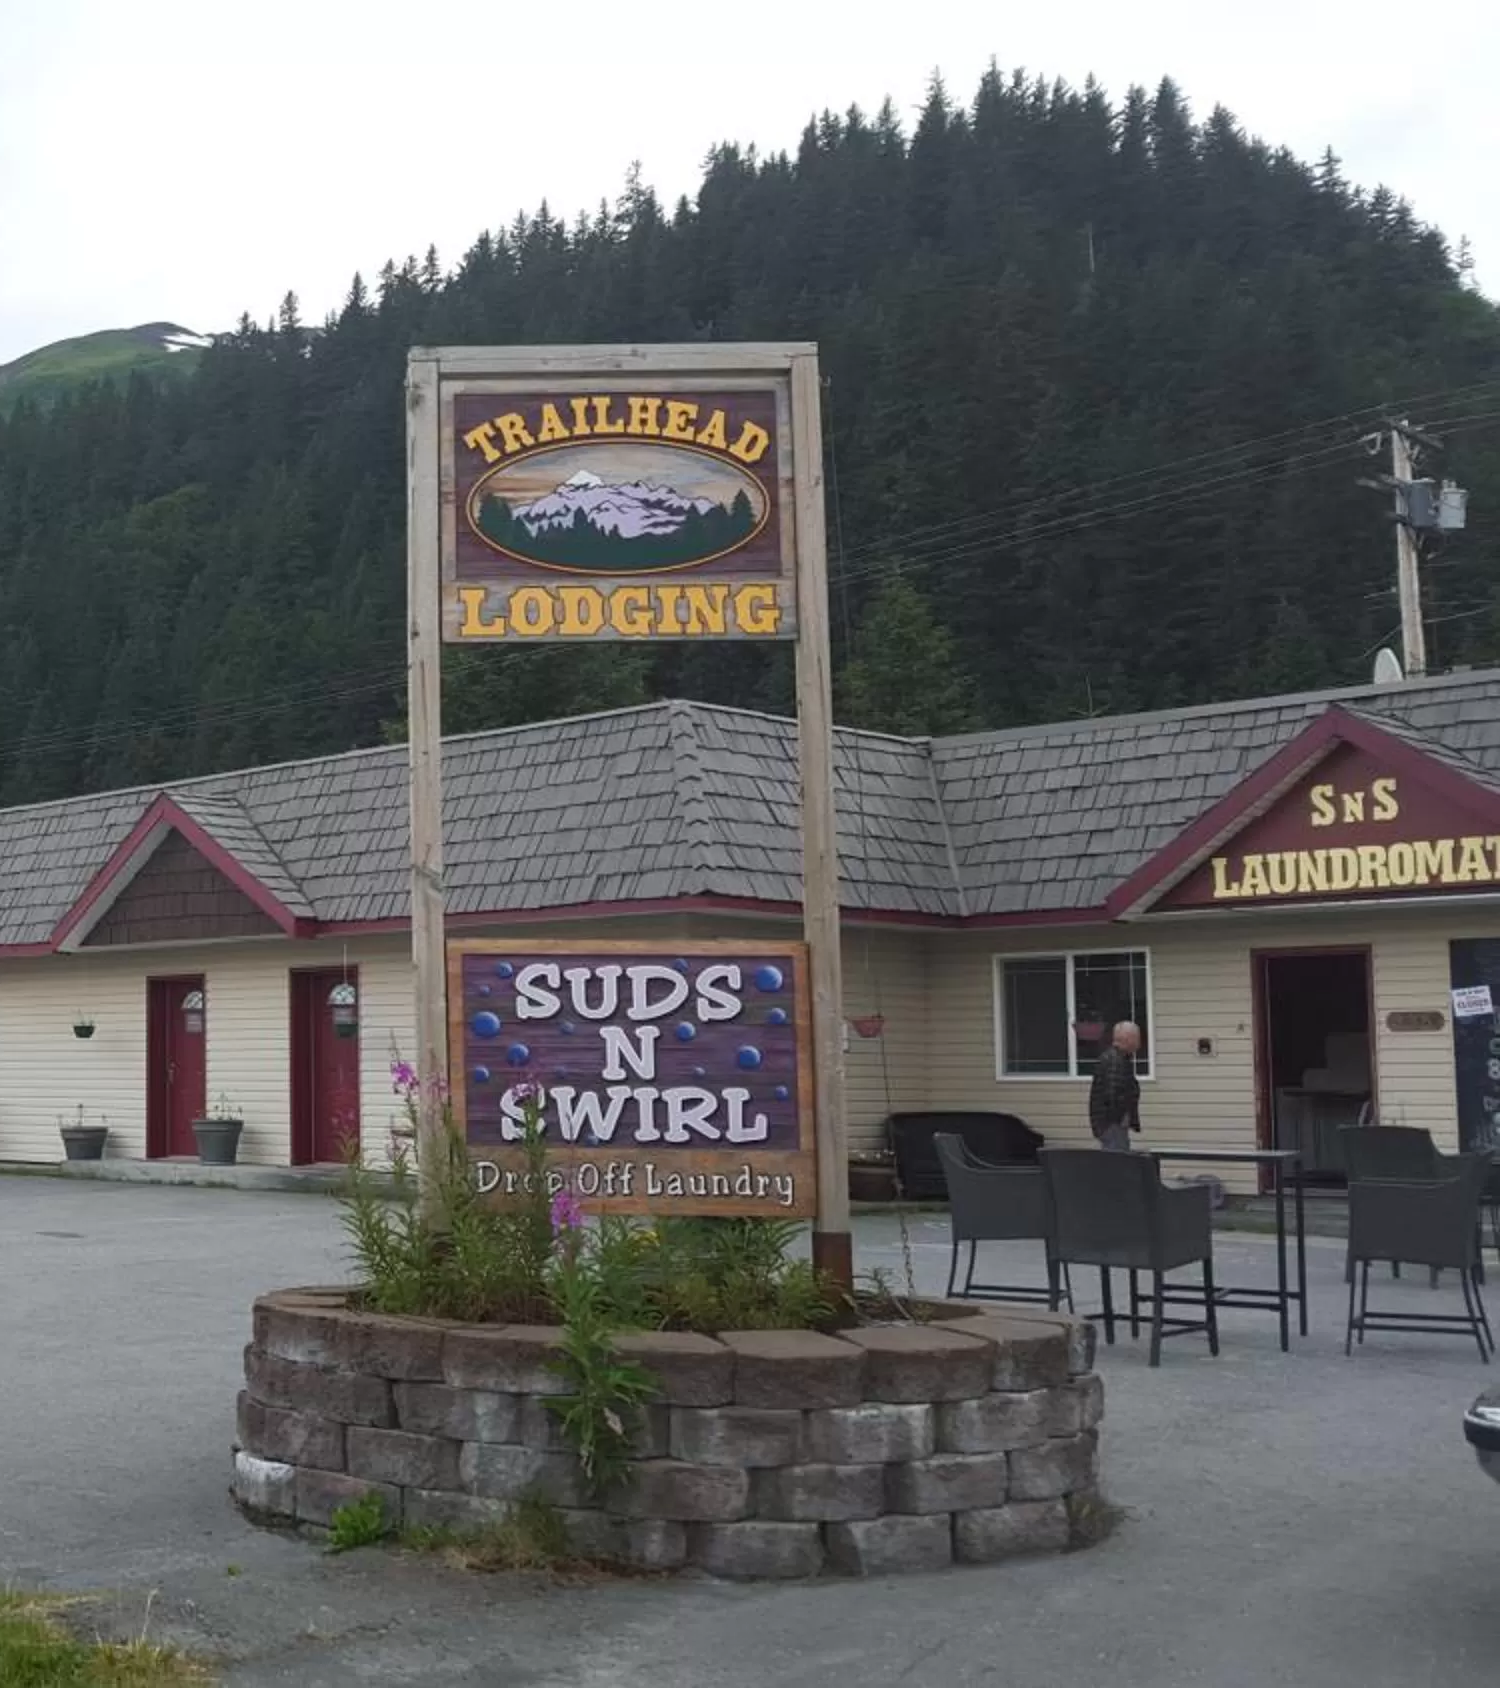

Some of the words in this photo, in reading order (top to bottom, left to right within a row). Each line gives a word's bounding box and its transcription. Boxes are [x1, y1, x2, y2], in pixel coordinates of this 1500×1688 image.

[464, 397, 770, 464] TRAILHEAD
[458, 585, 780, 637] LODGING
[514, 963, 743, 1022] SUDS
[599, 1025, 661, 1081] N
[500, 1083, 768, 1143] SWIRL
[577, 1163, 636, 1195] Off
[646, 1163, 794, 1205] Laundry
